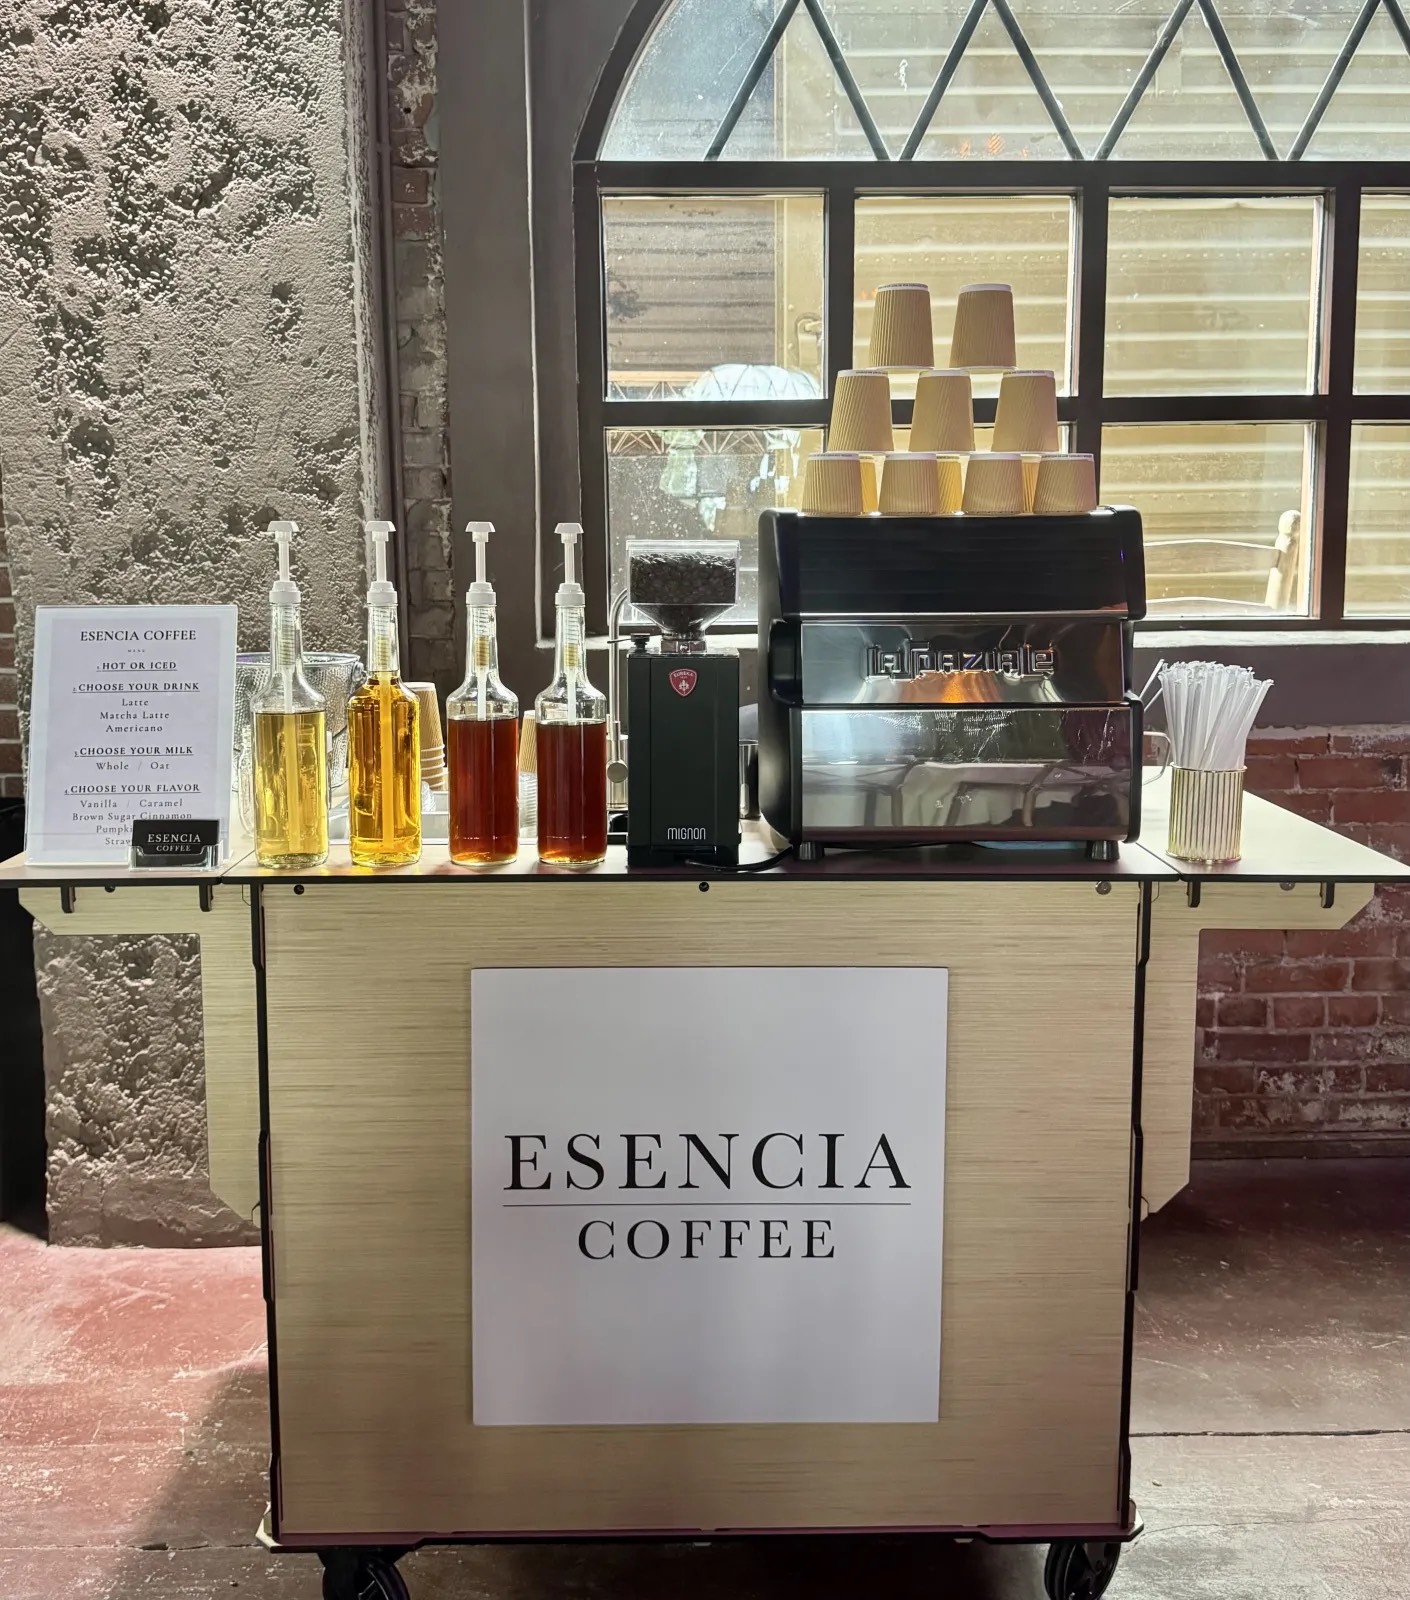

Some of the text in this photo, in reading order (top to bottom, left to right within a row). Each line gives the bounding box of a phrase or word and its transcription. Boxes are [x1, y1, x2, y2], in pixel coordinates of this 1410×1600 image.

[80, 629, 197, 641] ESENCIA COFFEE
[102, 661, 126, 670] HOT
[129, 661, 146, 670] OR
[150, 661, 177, 670] ICED
[78, 683, 124, 691] CHOOSE
[128, 682, 159, 691] YOUR
[163, 682, 200, 691] DRINK
[121, 698, 149, 707] Latte
[99, 710, 170, 720] Matcha Latte
[105, 724, 163, 733] Americano
[80, 747, 126, 755] CHOOSE
[130, 746, 161, 755] YOUR
[165, 746, 193, 754] MILK
[96, 761, 129, 770] Whole
[150, 761, 170, 770] Oat
[70, 785, 117, 793] CHOOSE
[121, 784, 152, 793] YOUR
[156, 783, 200, 792] FLAVOR
[80, 799, 118, 808] Vanilla
[139, 798, 183, 807] Caramel
[72, 811, 192, 822] Brown Sugar Cinnamon
[96, 824, 133, 835] Pumpki
[147, 833, 201, 843] ESENCIA
[503, 1132, 912, 1190] ESENCIA
[578, 1219, 836, 1260] COFFEE
